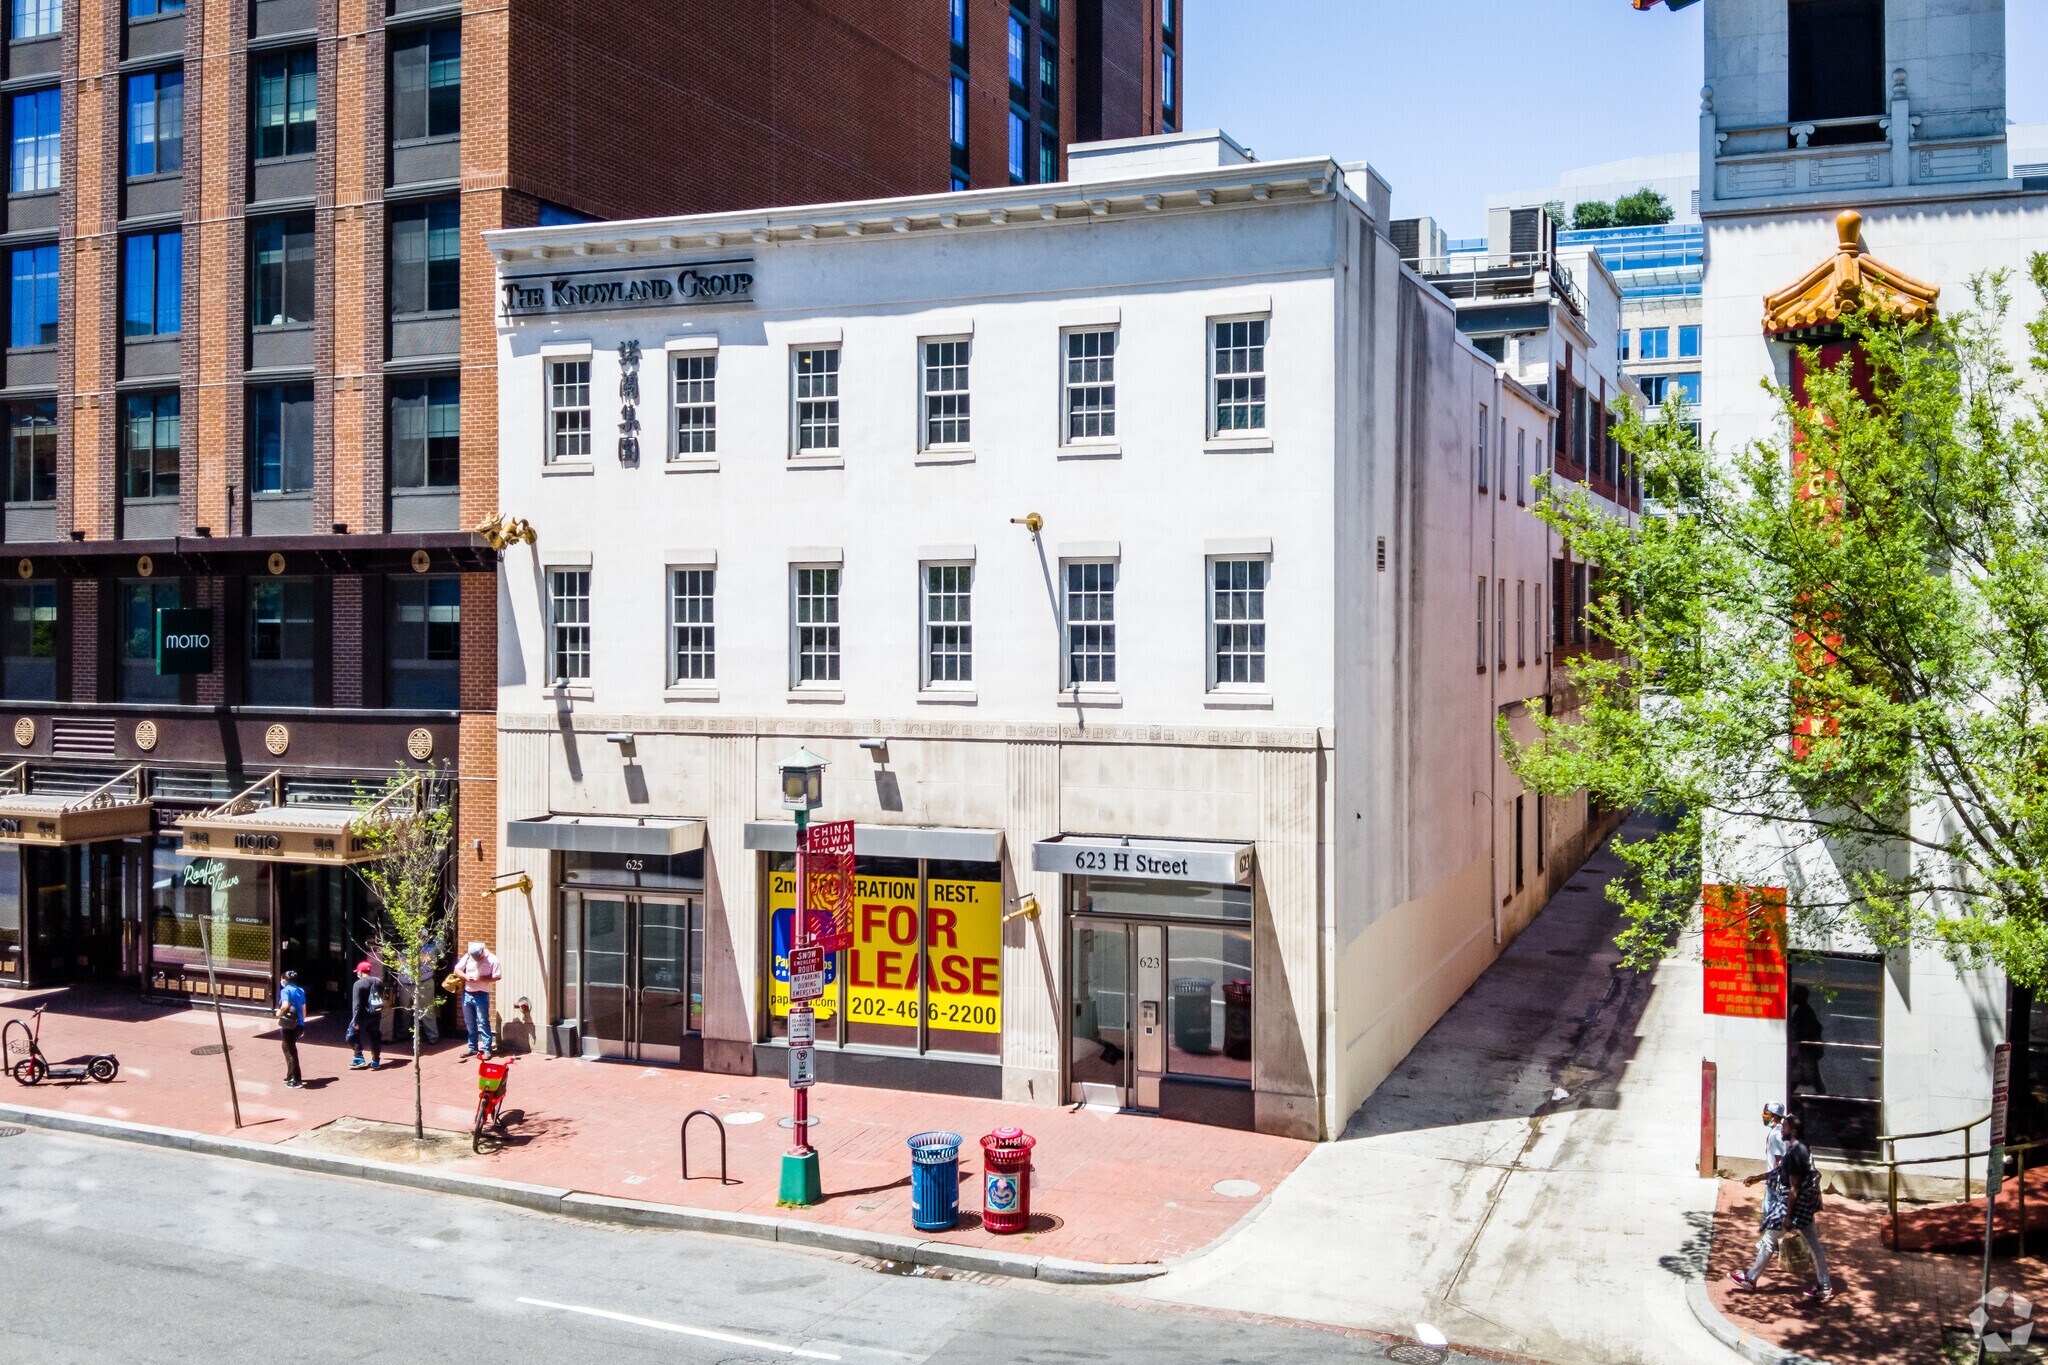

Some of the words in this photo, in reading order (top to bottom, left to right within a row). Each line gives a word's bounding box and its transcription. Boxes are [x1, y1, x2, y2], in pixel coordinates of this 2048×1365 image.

[166, 634, 210, 649] MOTTO
[813, 823, 851, 838] CHINA
[235, 832, 281, 851] MOTTO
[813, 833, 851, 847] TOWN
[626, 859, 643, 871] 625
[1075, 851, 1106, 870] 623
[1113, 853, 1130, 871] H
[1136, 854, 1189, 875] Street
[1239, 853, 1250, 874] 623
[183, 857, 226, 886] Rooftop
[208, 869, 240, 893] Views
[774, 876, 797, 894] 2n
[934, 883, 979, 903] REST.
[861, 903, 958, 948] FOR
[793, 958, 820, 967] EMERGENCY
[797, 950, 817, 960] SNOW
[1139, 956, 1160, 969] 623
[797, 964, 816, 974] ROUTE
[849, 948, 1000, 998] LEASE
[801, 973, 820, 981] PARKING
[797, 981, 817, 989] DURING
[792, 988, 821, 998] EMERGENCY
